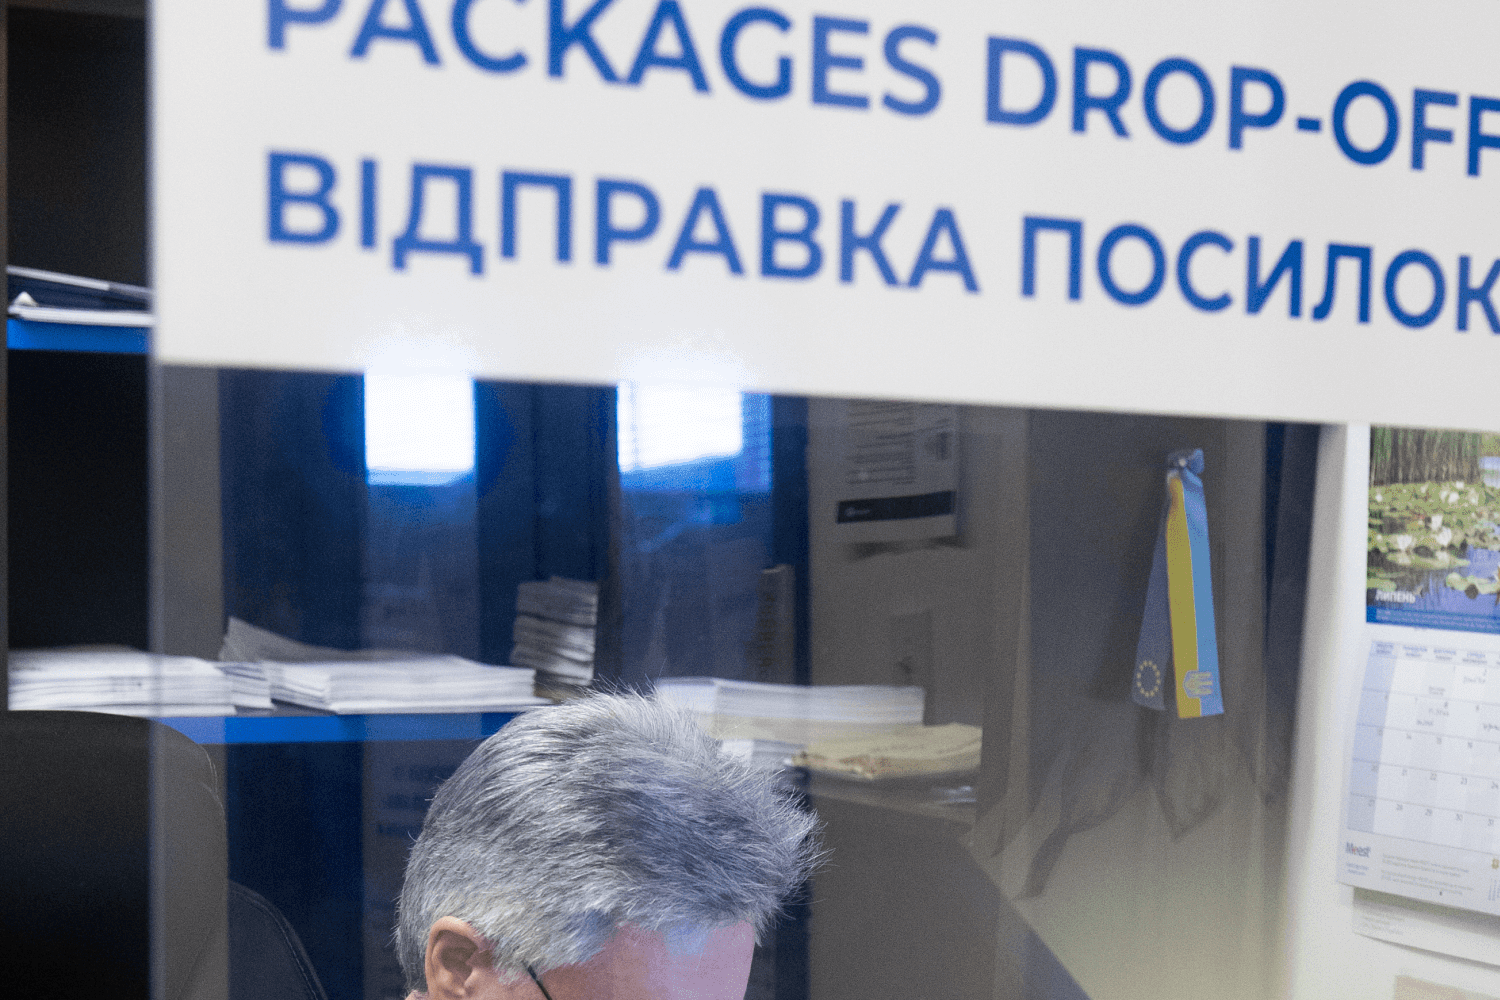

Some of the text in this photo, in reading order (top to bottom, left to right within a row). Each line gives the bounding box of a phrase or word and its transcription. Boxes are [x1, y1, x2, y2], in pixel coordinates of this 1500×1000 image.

[266, 0, 1500, 178] PACKAGES DROP-OFF
[266, 151, 1500, 334] ВІДПРАВКА ПОСИЛОК
